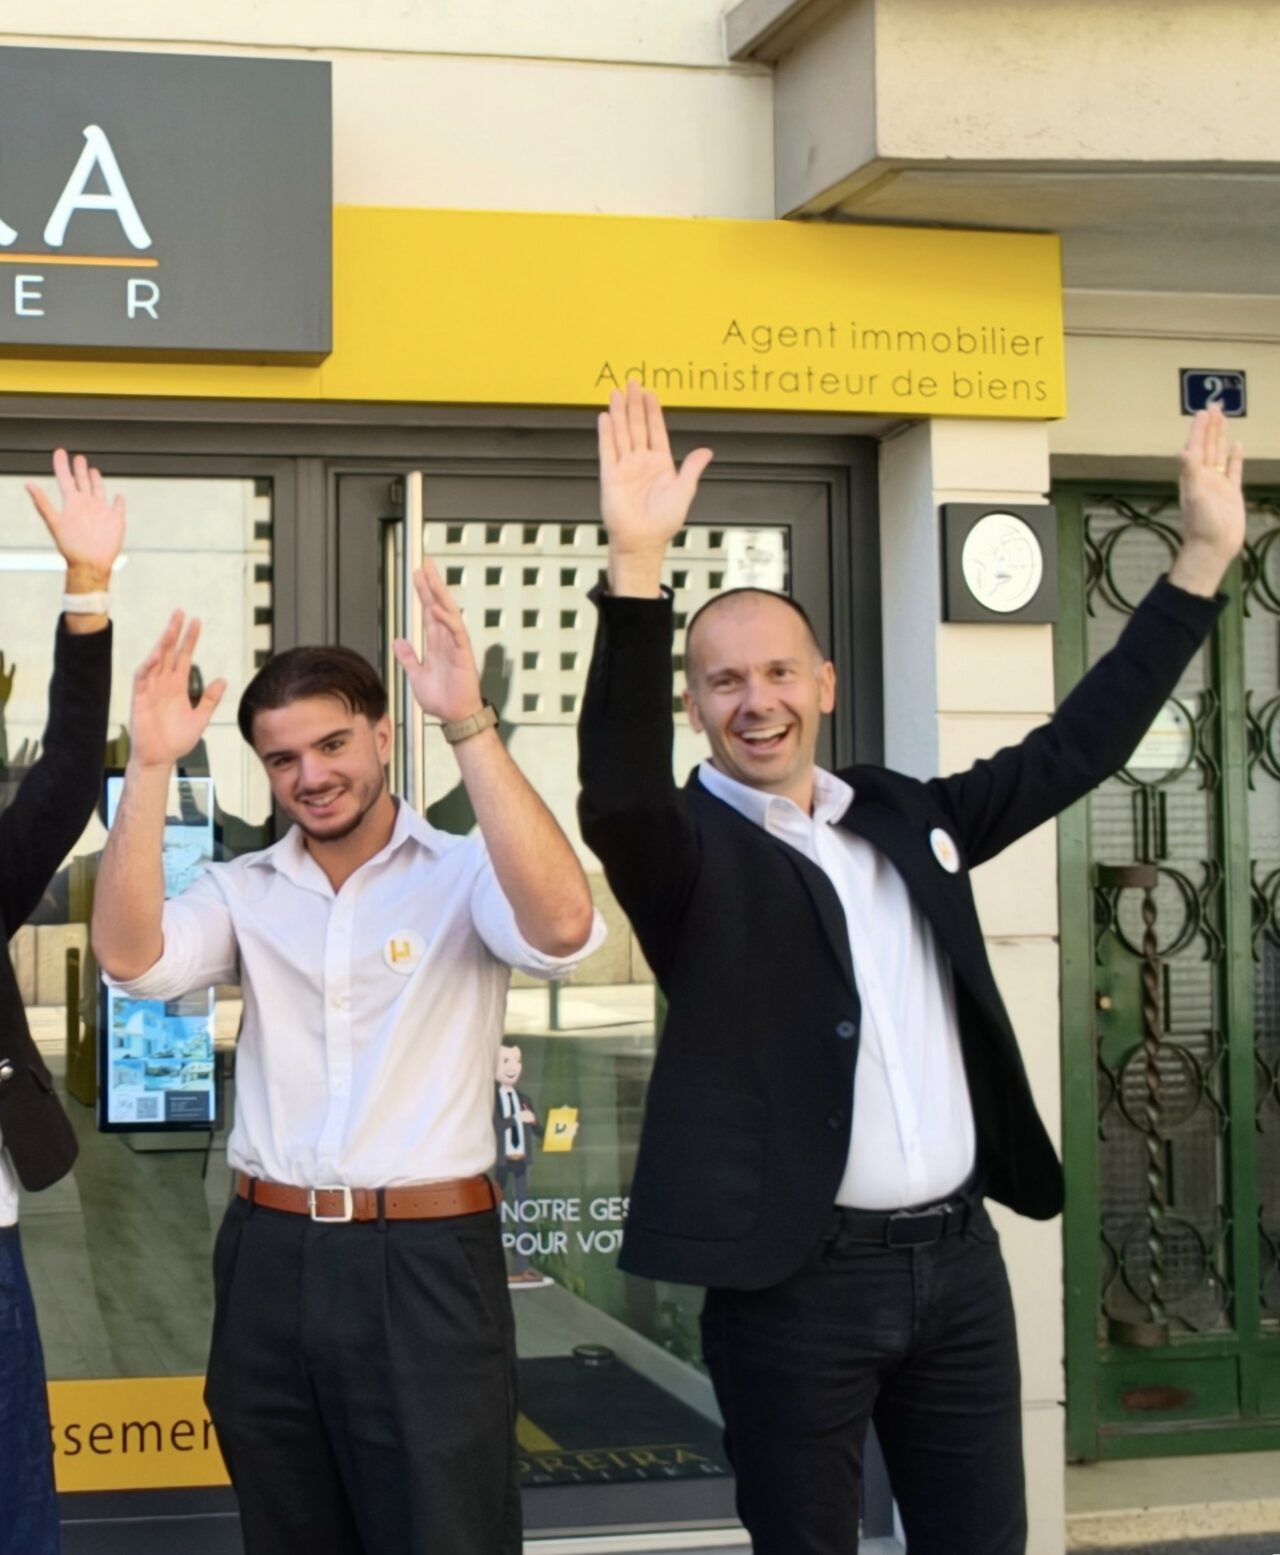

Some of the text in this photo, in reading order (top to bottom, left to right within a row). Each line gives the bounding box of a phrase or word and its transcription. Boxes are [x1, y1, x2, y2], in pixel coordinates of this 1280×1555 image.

[721, 319, 1045, 357] Agent immobilier
[593, 360, 1048, 402] Administrateur de biens
[1203, 375, 1225, 408] 2
[500, 1198, 582, 1223] NOTRE
[501, 1231, 568, 1256] POUR
[51, 1418, 213, 1456] seme
